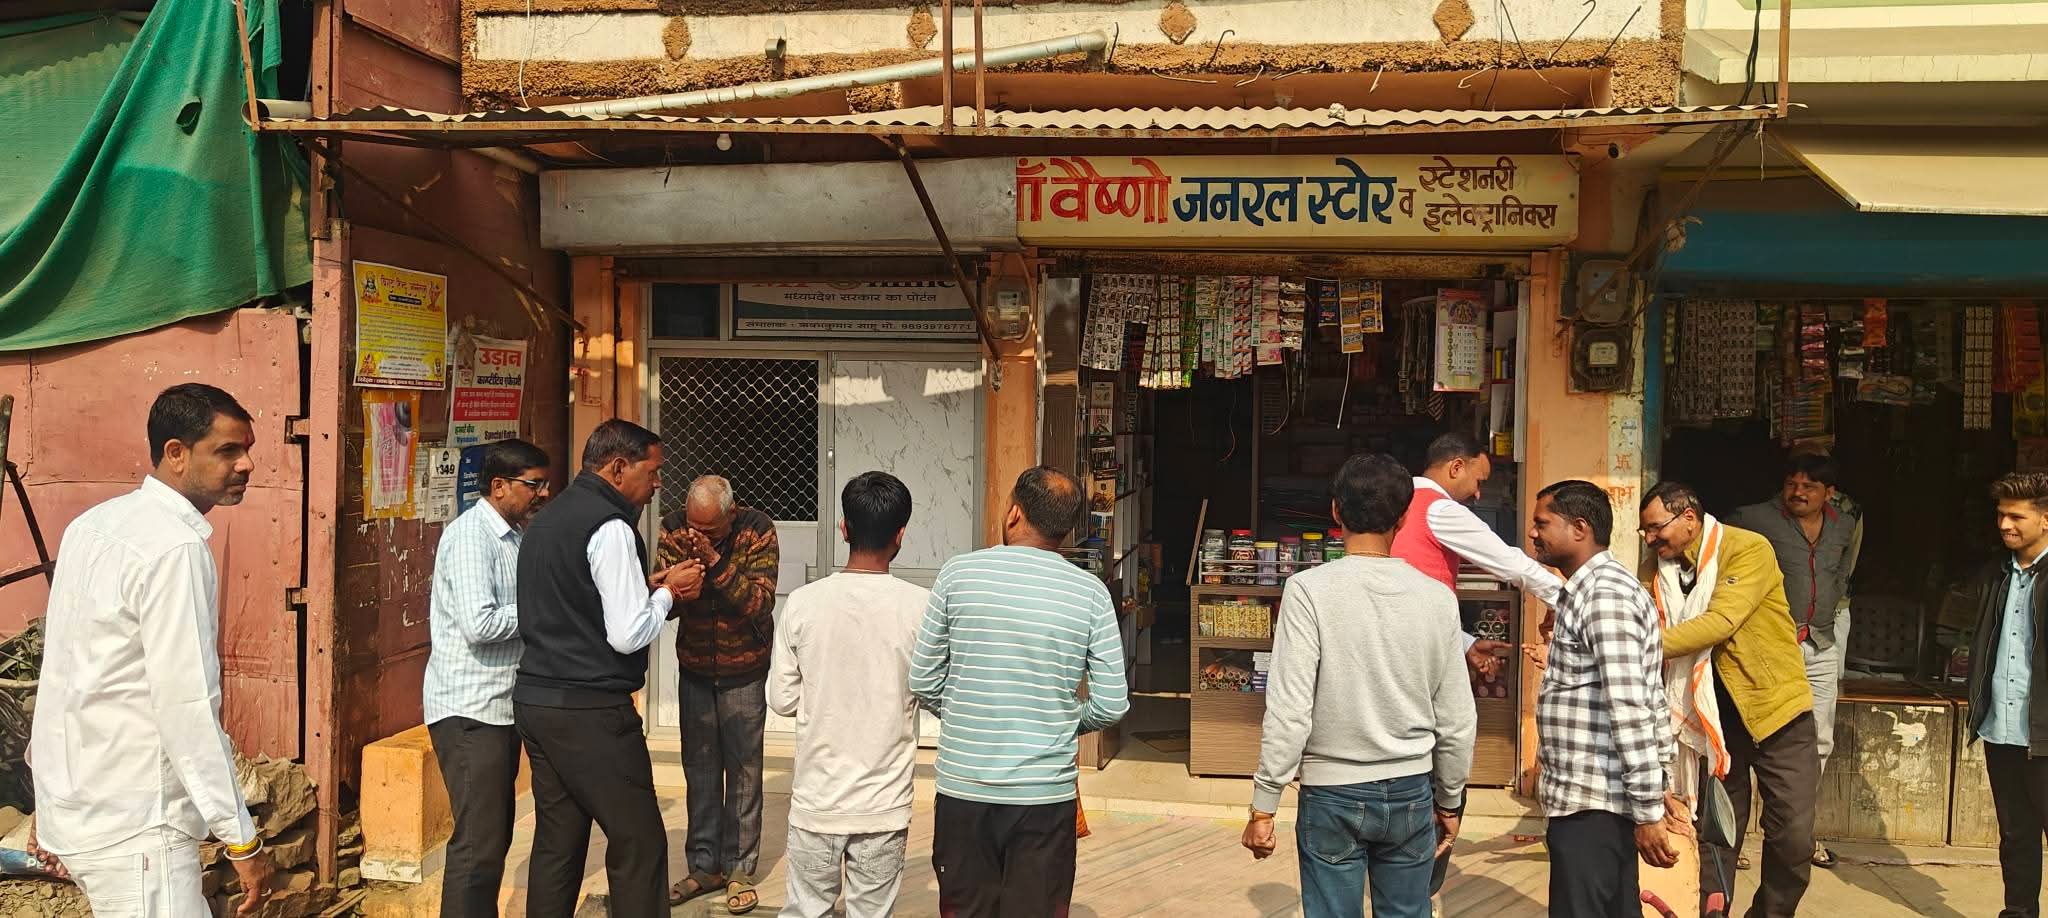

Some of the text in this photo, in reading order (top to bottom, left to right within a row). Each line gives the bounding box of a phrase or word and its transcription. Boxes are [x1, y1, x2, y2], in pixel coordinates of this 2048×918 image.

[1419, 156, 1516, 192] स्टेशनरी
[1050, 156, 1172, 224] वैष्णो
[1173, 176, 1303, 226] जनरल
[1306, 157, 1397, 225] स्टोर
[1398, 188, 1416, 218] व
[783, 291, 937, 302] मध्यप्रदेश सरकार का पोर्टल
[479, 348, 521, 371] उड़ान
